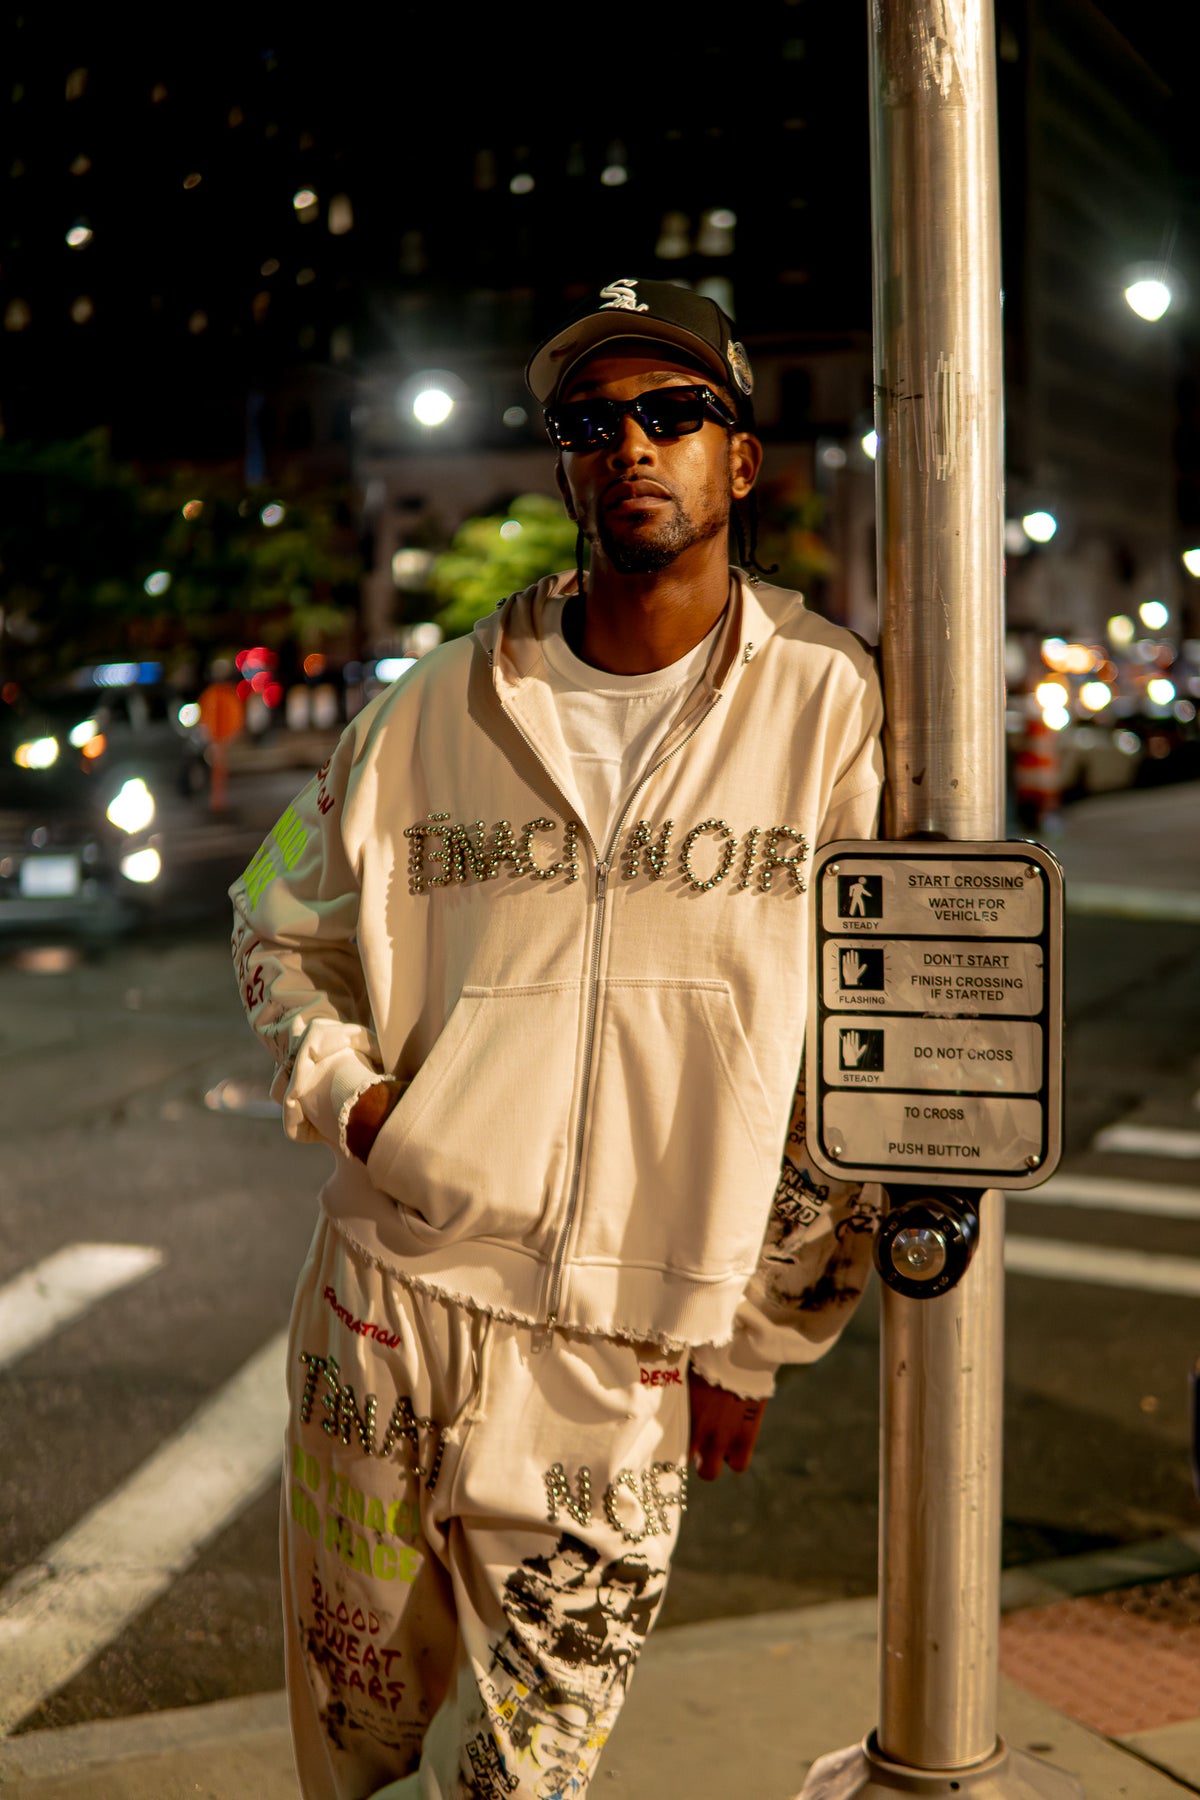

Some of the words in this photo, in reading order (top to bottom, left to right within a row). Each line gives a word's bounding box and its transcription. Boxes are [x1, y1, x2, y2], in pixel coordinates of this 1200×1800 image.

[626, 818, 811, 893] NOIR
[908, 876, 951, 887] START
[954, 876, 1024, 889] CROSSING
[928, 898, 974, 910] WATCH
[978, 898, 1006, 910] FOR
[935, 911, 998, 922] VEHICLES
[842, 921, 879, 930] STEADY
[923, 954, 964, 966] DON'T
[967, 955, 1009, 967] START
[911, 976, 952, 988] FINISH
[955, 976, 1023, 989] CROSSING
[839, 996, 885, 1005] FLASHING
[930, 989, 942, 999] IF
[945, 989, 1004, 1001] STARTED
[914, 1047, 932, 1058] DO
[936, 1048, 964, 1060] NOT
[967, 1049, 1013, 1061] CROSS
[843, 1074, 880, 1083] STEADY
[904, 1107, 920, 1118] TO
[923, 1107, 964, 1120] CROSS
[889, 1143, 924, 1156] PUSH
[927, 1144, 980, 1157] BUTTON
[324, 1513, 421, 1586] PEACE
[312, 1576, 380, 1635] BLOOD
[314, 1611, 402, 1677] SWEAT
[323, 1646, 405, 1713] TEARS
